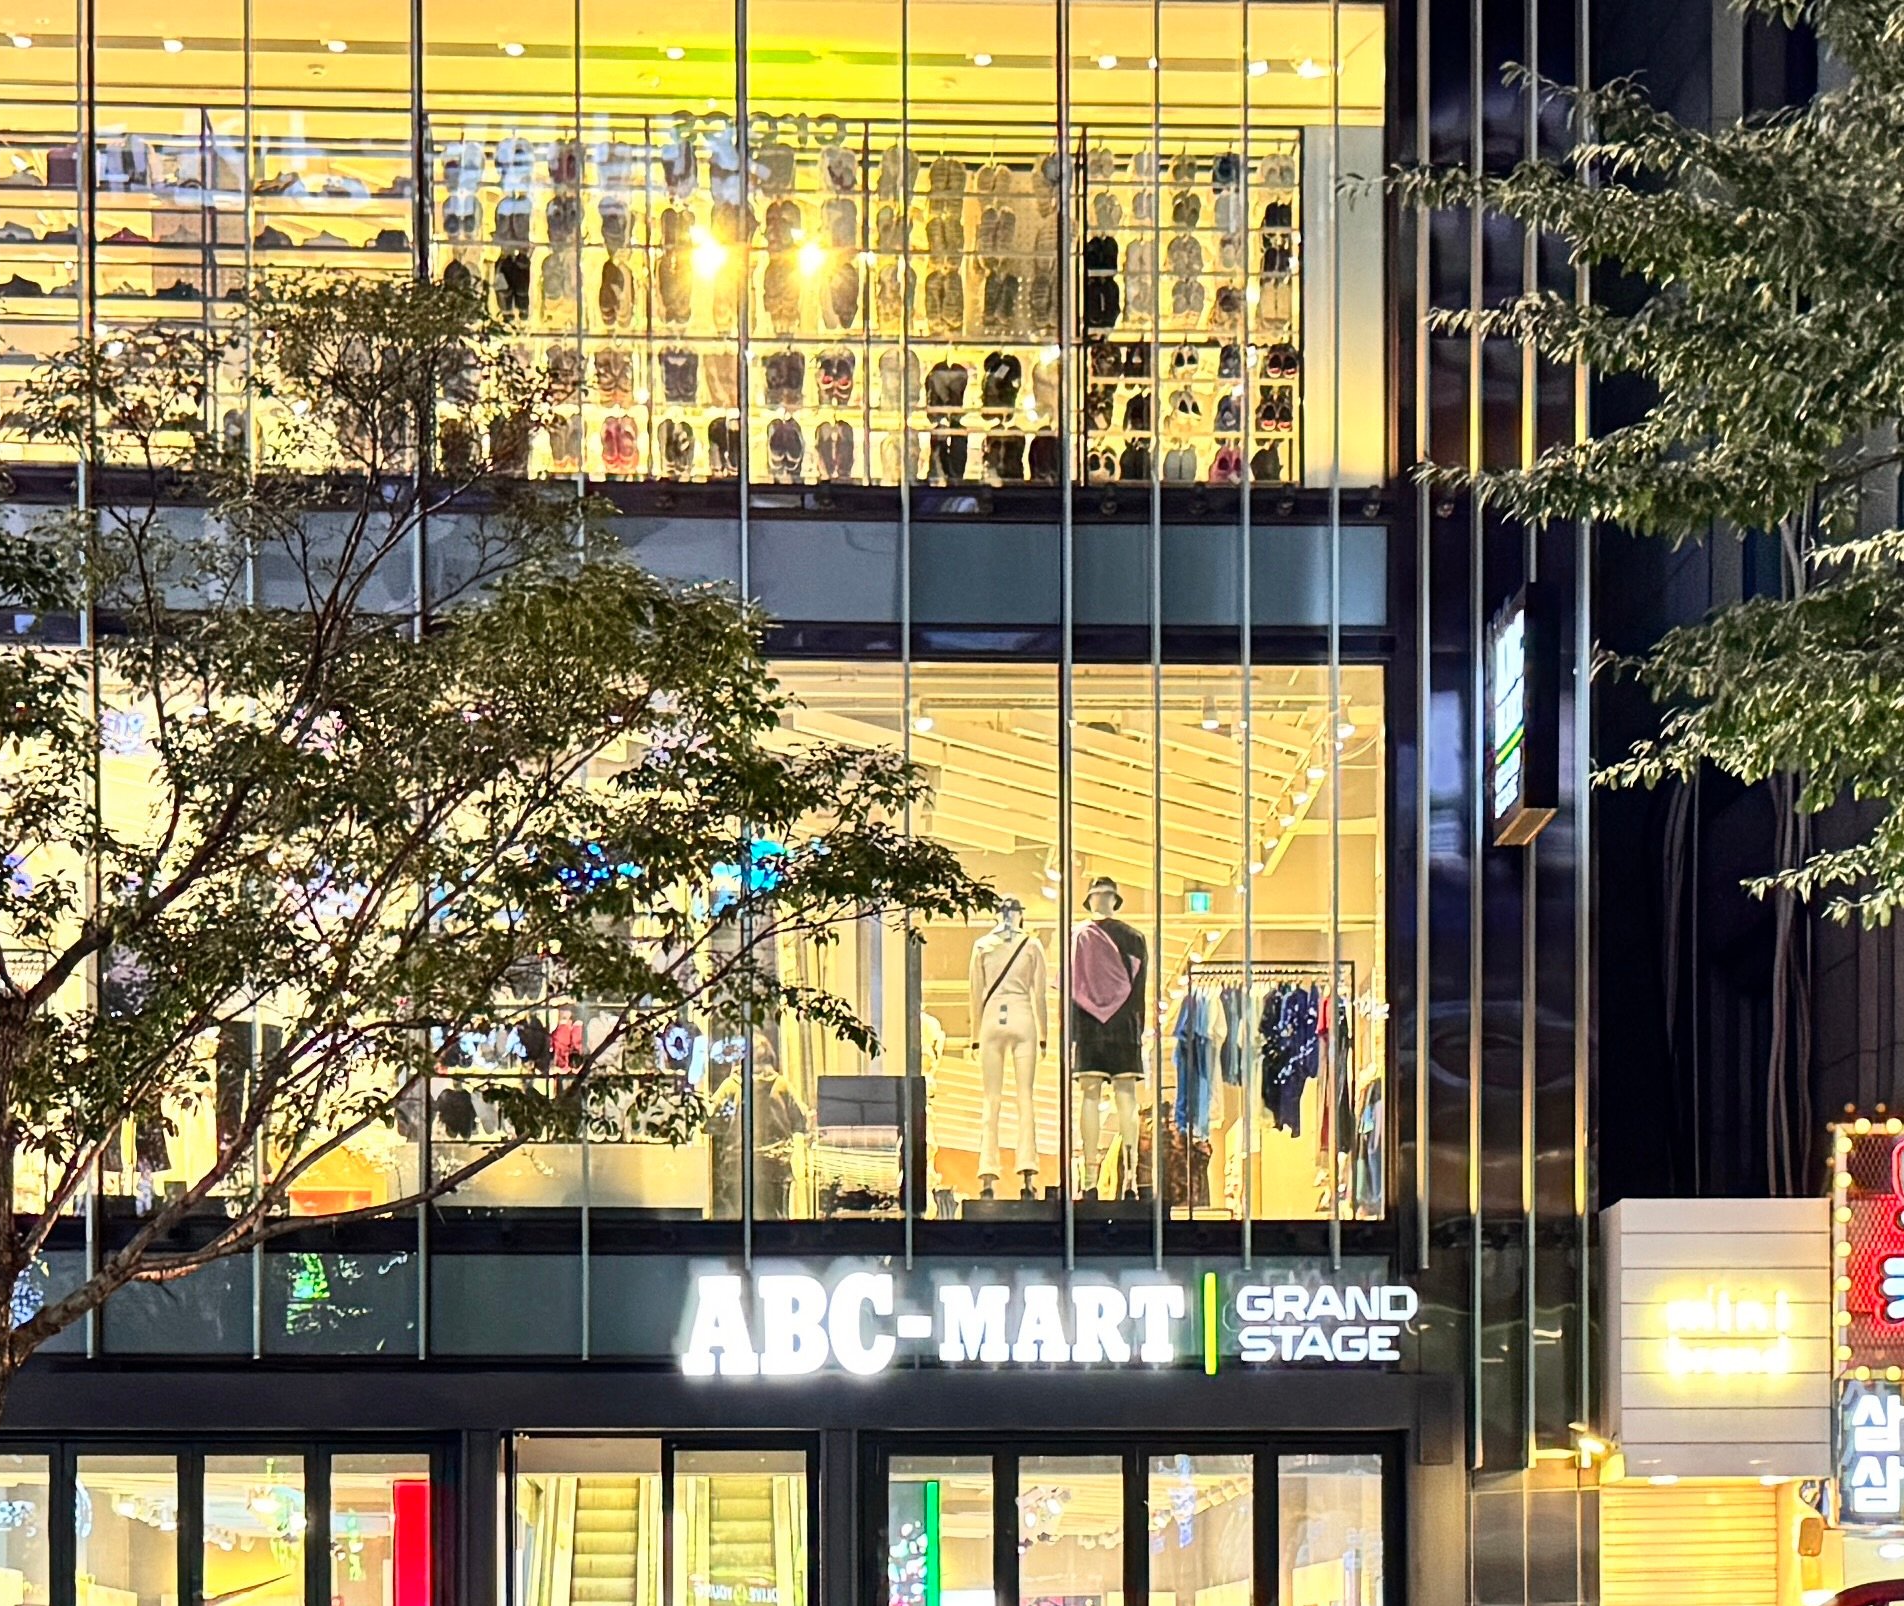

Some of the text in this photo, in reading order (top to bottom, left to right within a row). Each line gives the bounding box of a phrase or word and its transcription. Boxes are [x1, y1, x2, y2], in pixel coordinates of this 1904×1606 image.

[1237, 1285, 1418, 1321] GRAND
[682, 1272, 1185, 1376] ABC-MART
[1238, 1326, 1401, 1362] STAGE
